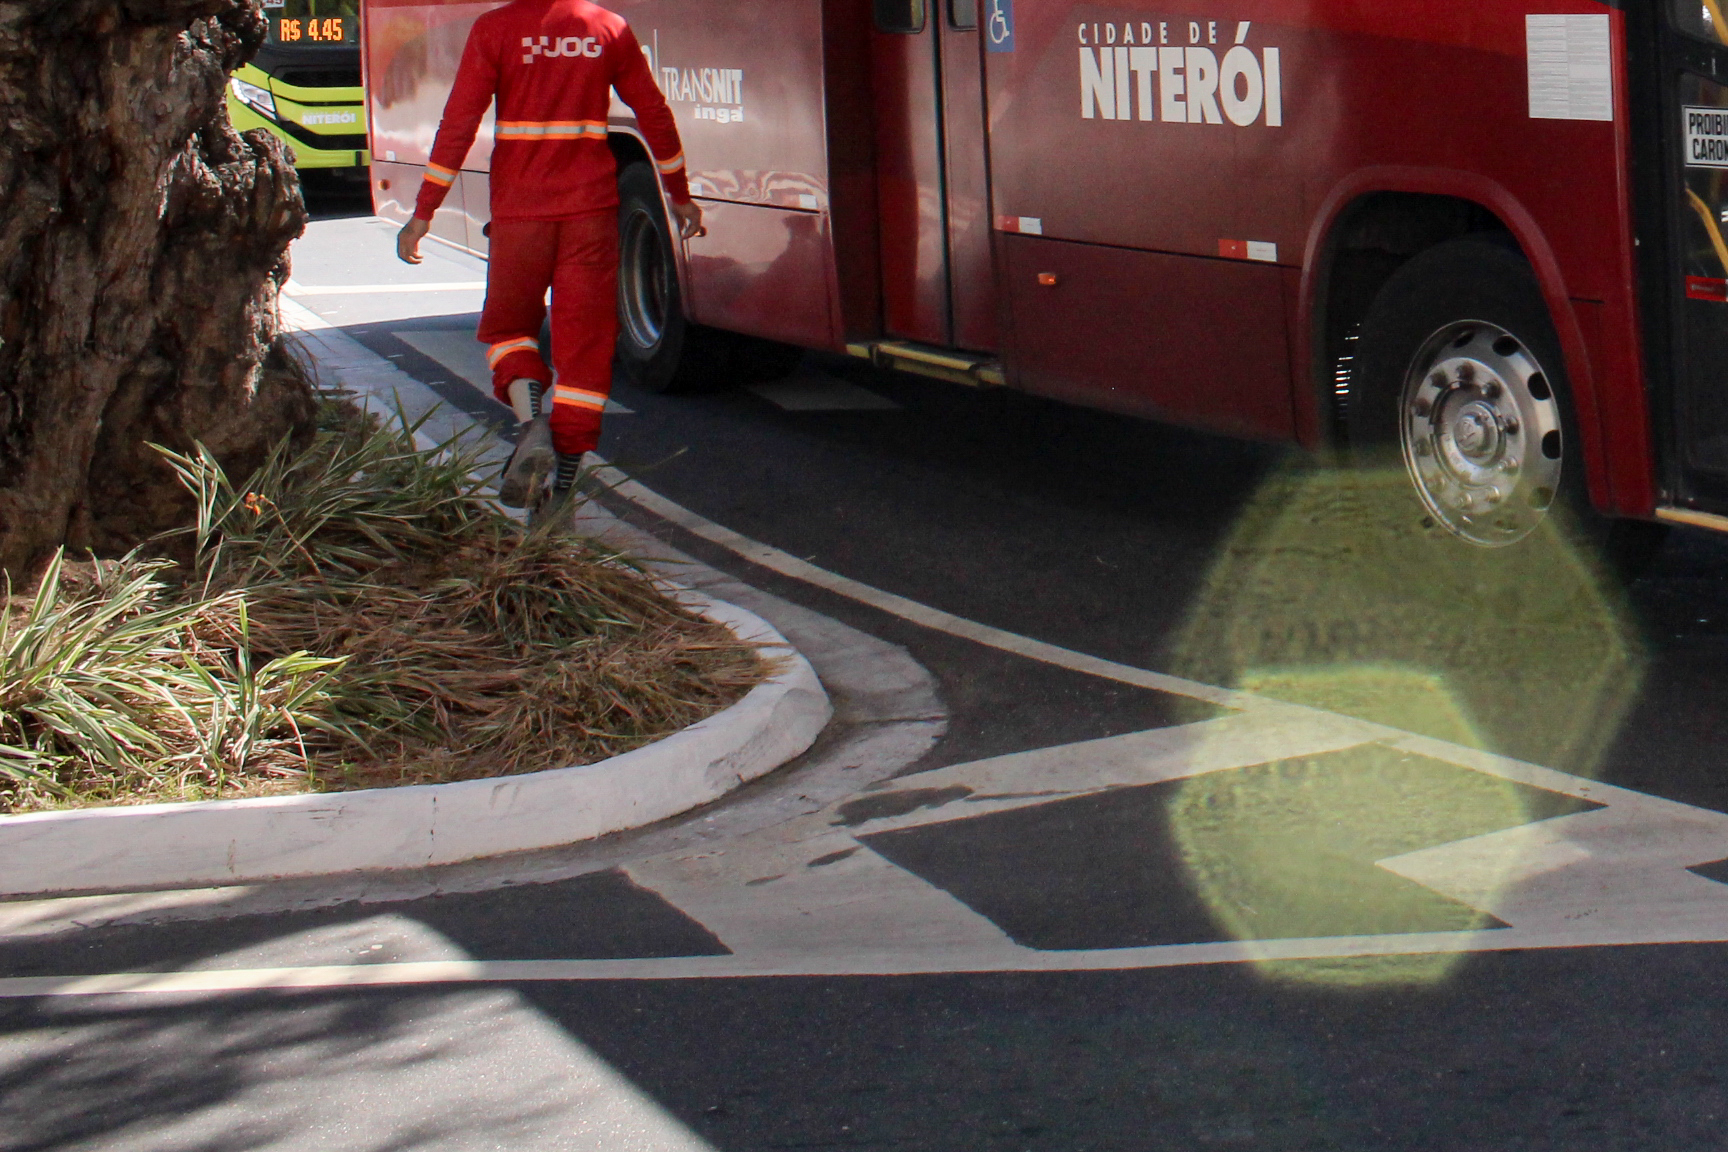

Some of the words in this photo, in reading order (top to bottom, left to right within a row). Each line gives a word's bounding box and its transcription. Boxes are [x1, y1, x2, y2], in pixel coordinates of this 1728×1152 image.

[280, 18, 301, 42] R$
[308, 18, 343, 42] 4.45
[1078, 22, 1168, 45] CIDADE
[1189, 21, 1217, 45] DE
[543, 37, 602, 59] JOG
[662, 67, 744, 105] TRANSNIT
[1079, 21, 1283, 127] NITERÓI
[303, 110, 356, 126] NITERÓI
